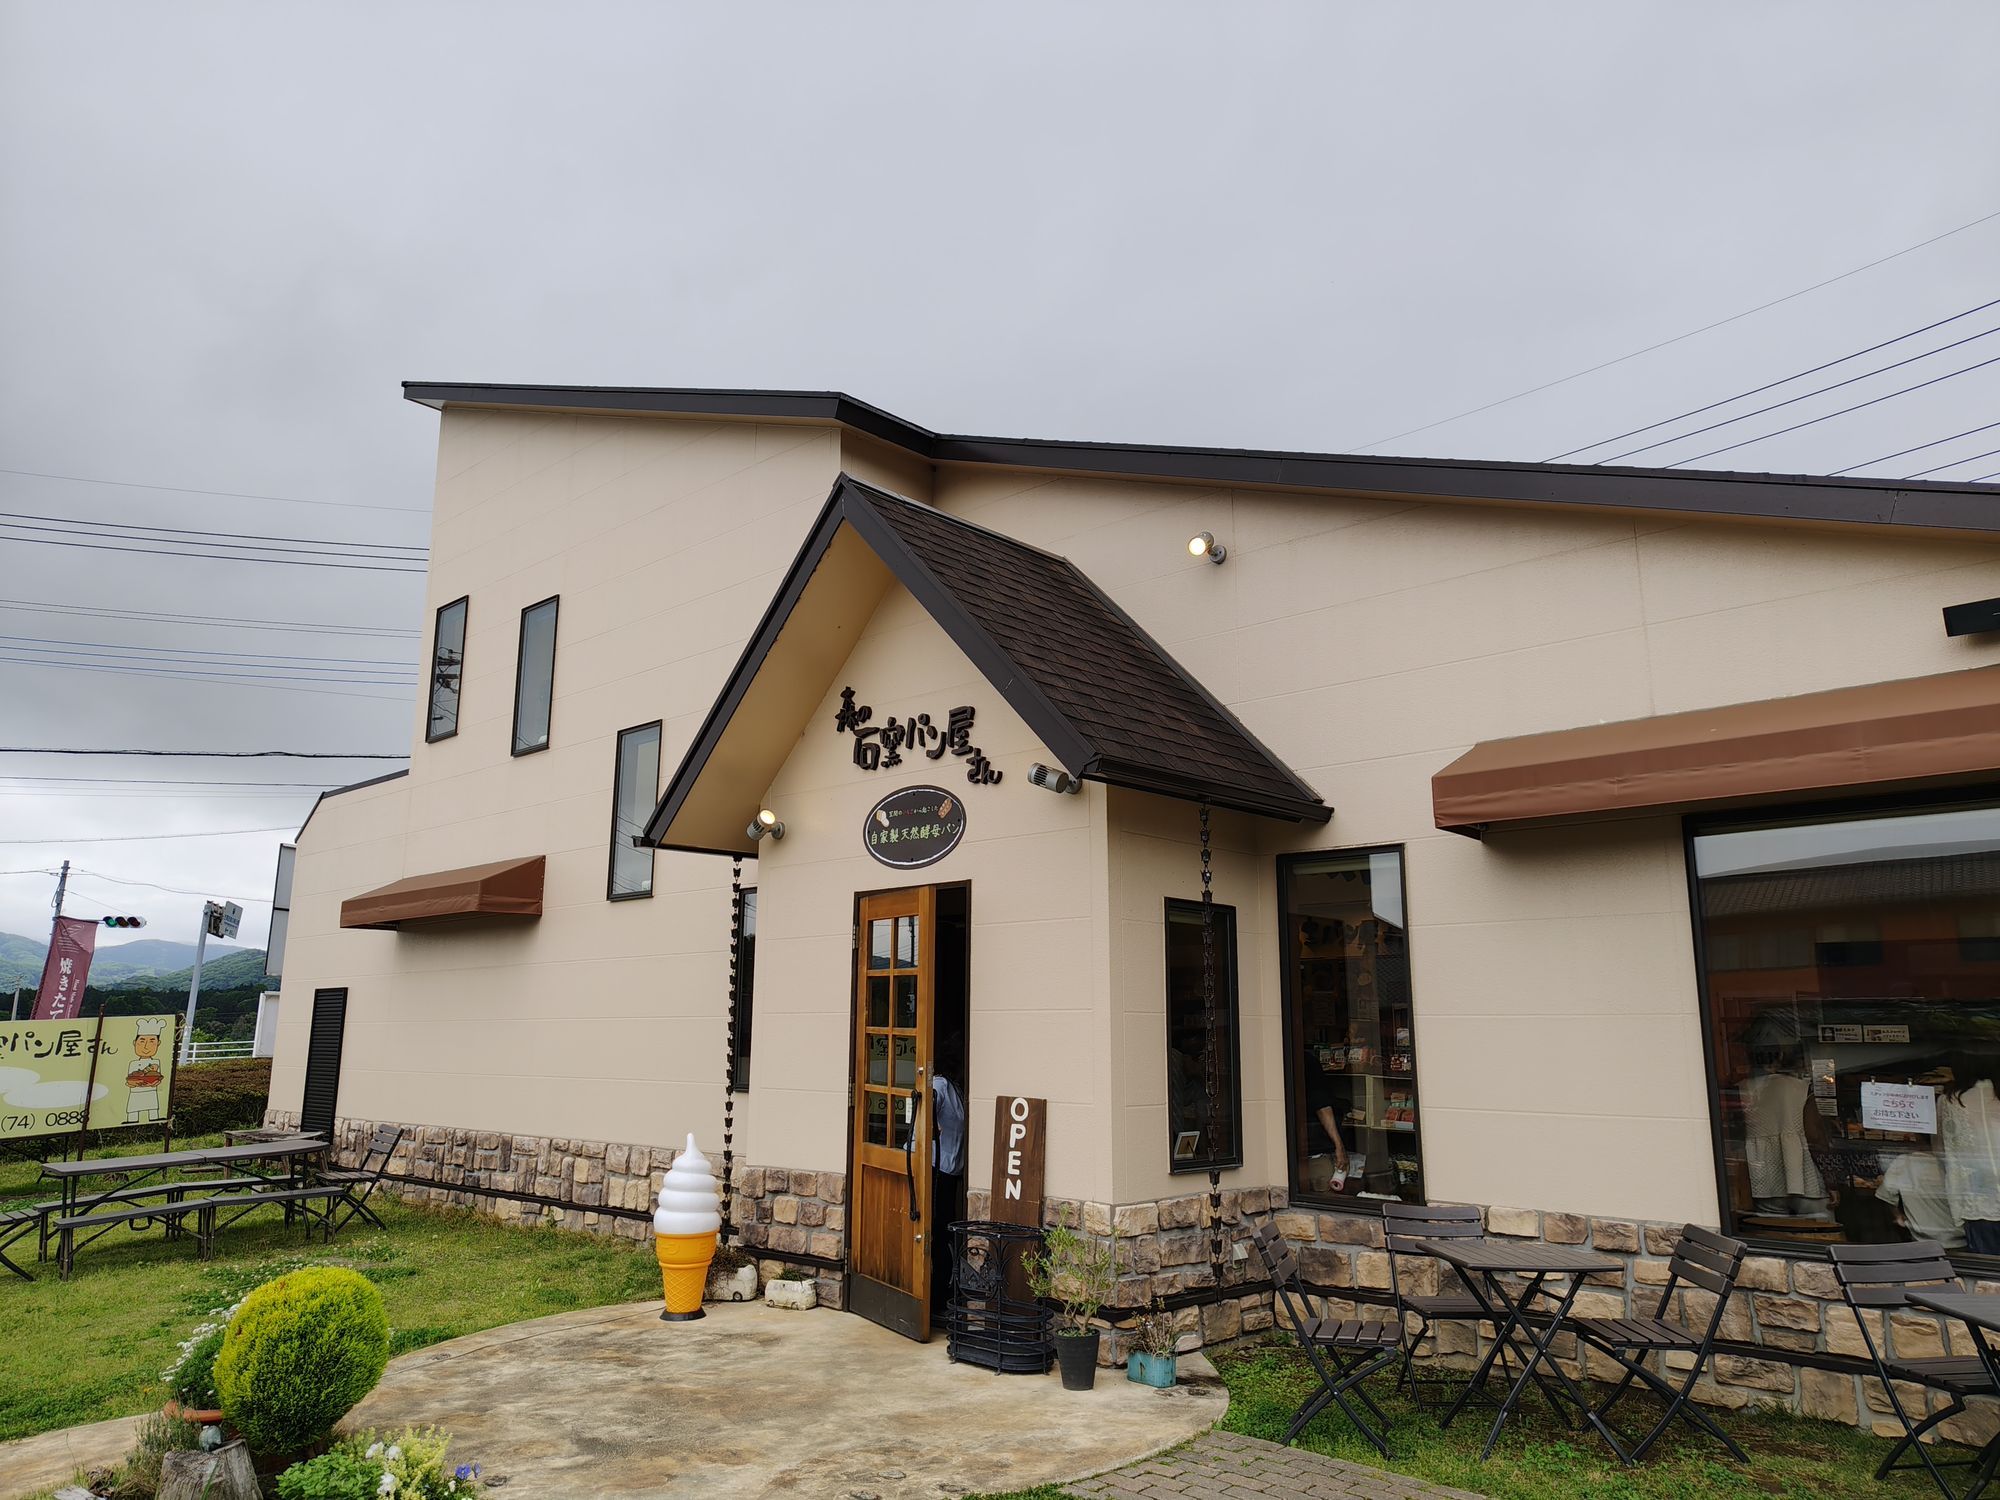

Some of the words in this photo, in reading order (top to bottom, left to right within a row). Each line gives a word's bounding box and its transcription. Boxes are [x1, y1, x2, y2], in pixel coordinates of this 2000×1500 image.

[871, 823, 960, 846] 自家製天然酵母パン
[0, 1029, 119, 1059] パン屋さん
[1005, 1097, 1029, 1200] OPEN
